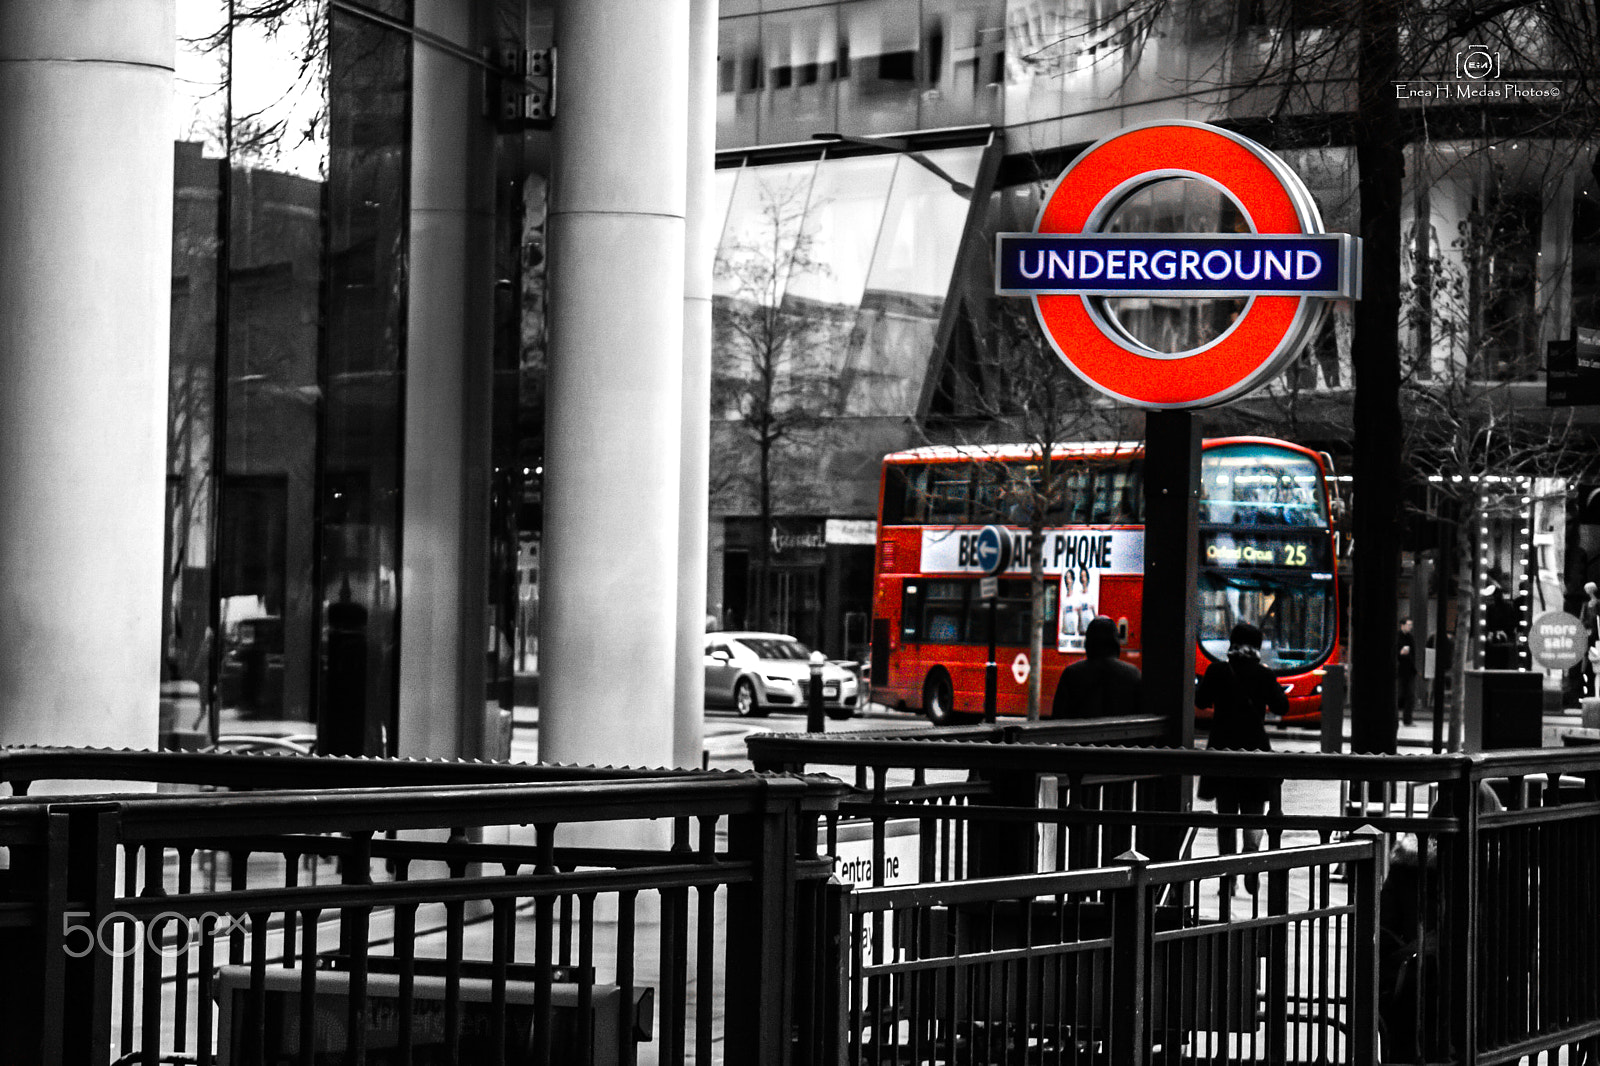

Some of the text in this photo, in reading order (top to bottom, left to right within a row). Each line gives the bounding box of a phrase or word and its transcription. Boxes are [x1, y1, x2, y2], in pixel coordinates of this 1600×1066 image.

[1018, 249, 1323, 281] UNDERGROUND
[1053, 534, 1113, 569] PHONE
[1284, 544, 1307, 567] 25
[1540, 624, 1576, 636] more
[1544, 636, 1573, 649] sale
